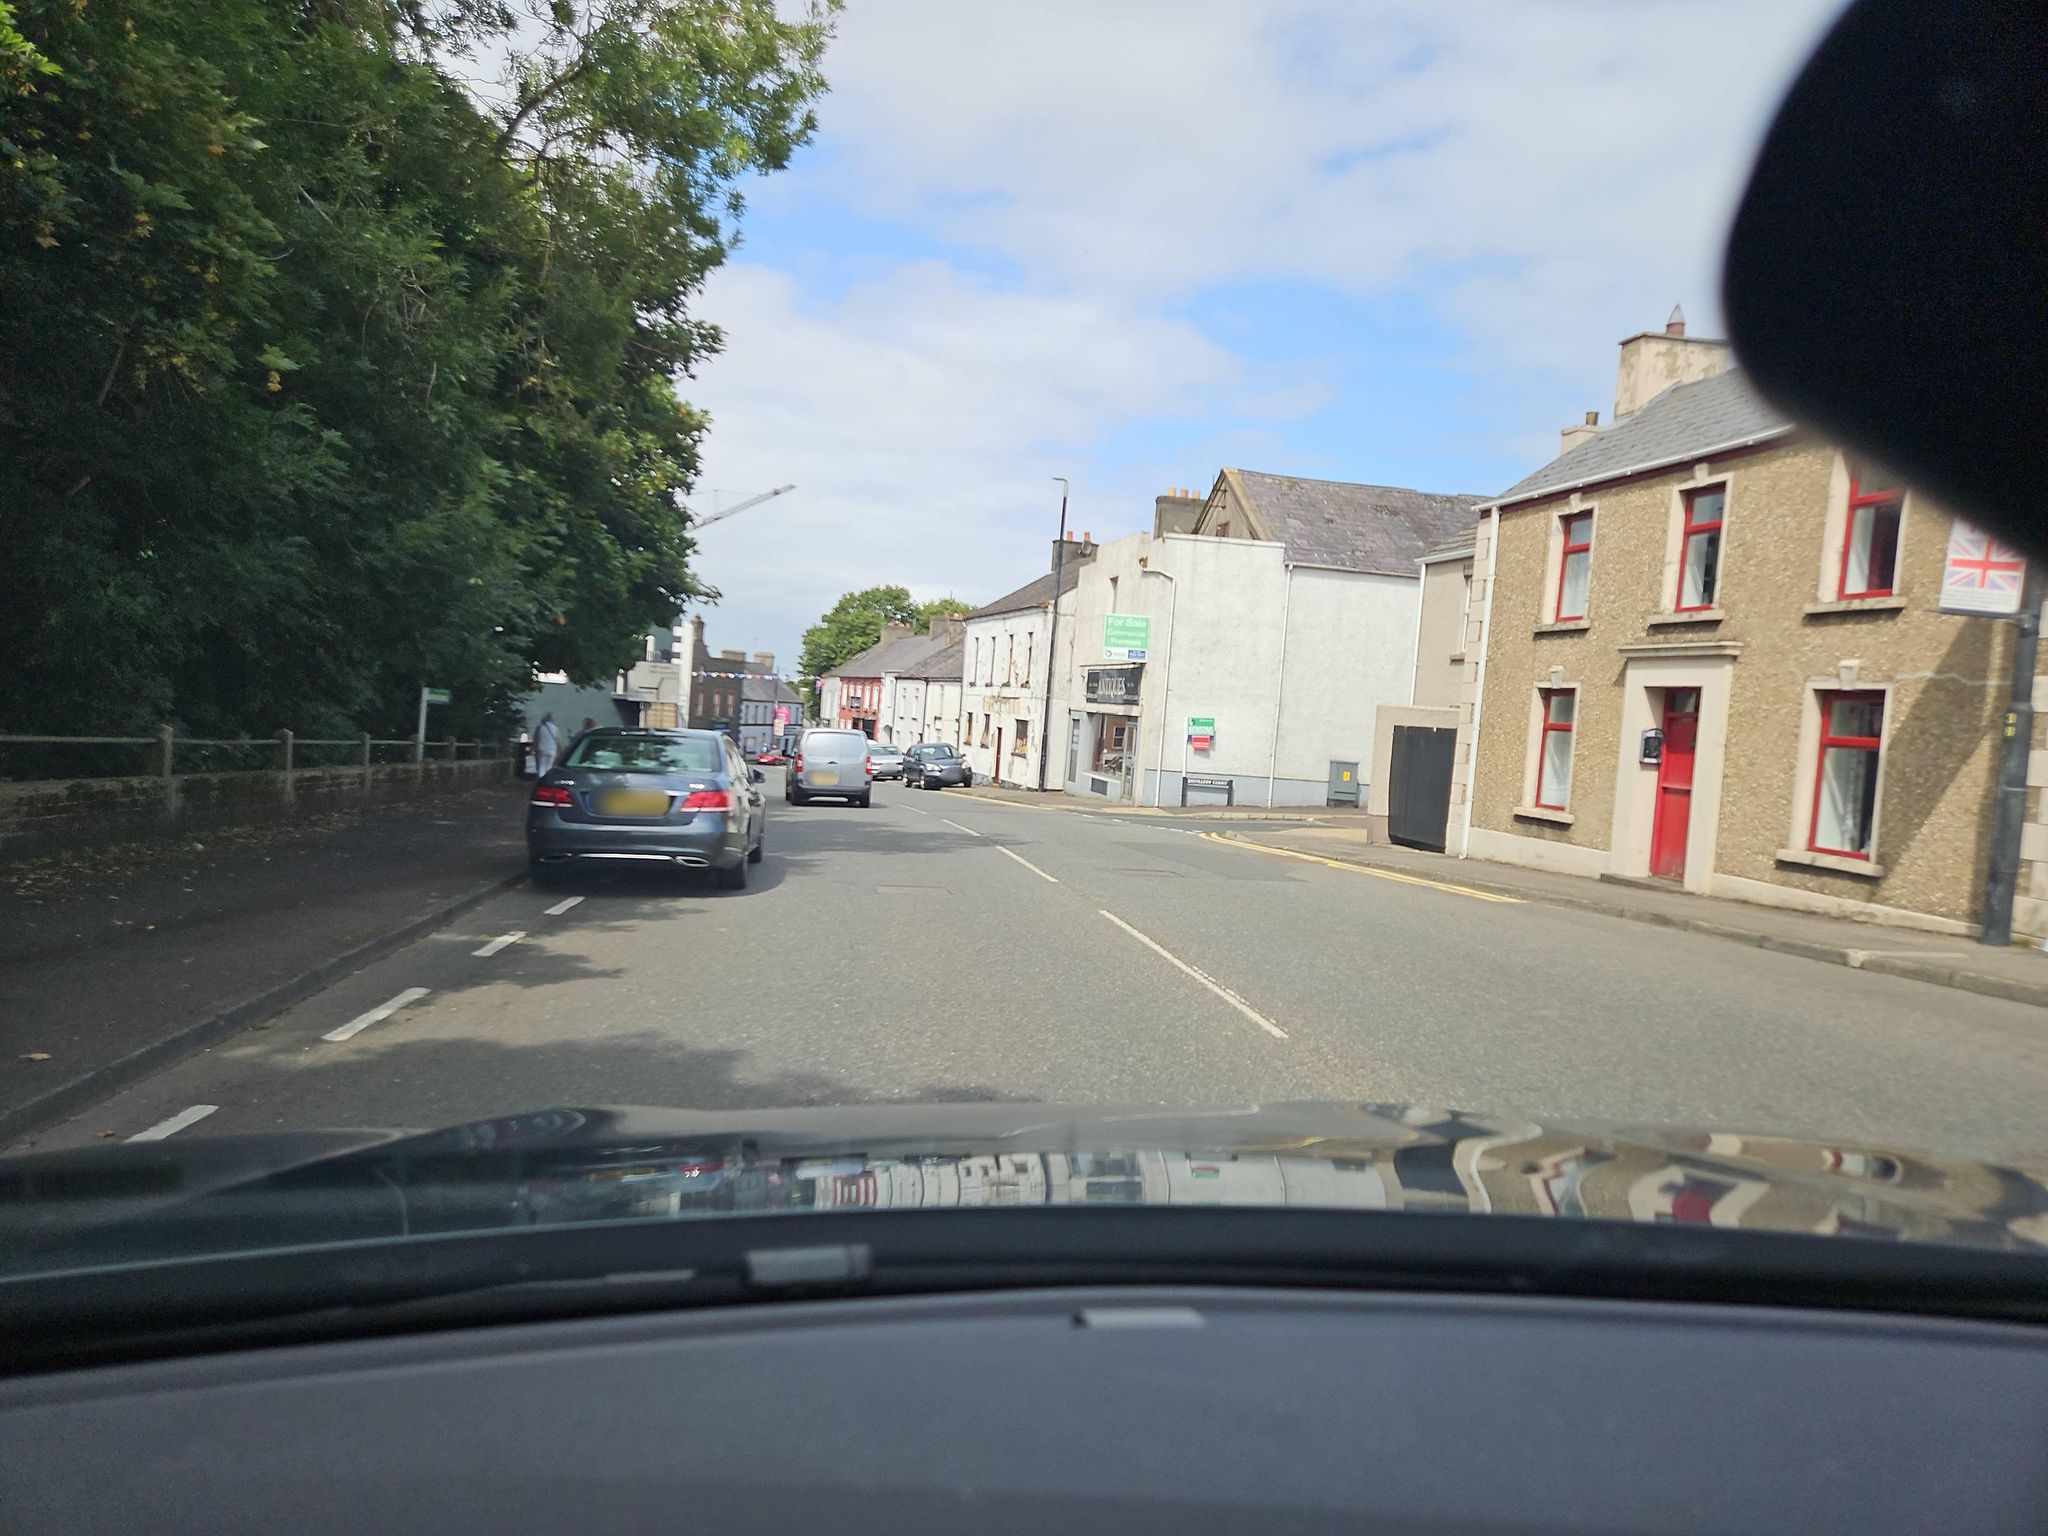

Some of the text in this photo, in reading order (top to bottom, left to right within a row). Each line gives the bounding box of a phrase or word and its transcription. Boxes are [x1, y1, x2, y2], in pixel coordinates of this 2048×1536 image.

[1108, 617, 1147, 628] For Sale
[1097, 676, 1126, 699] ANTIQUES
